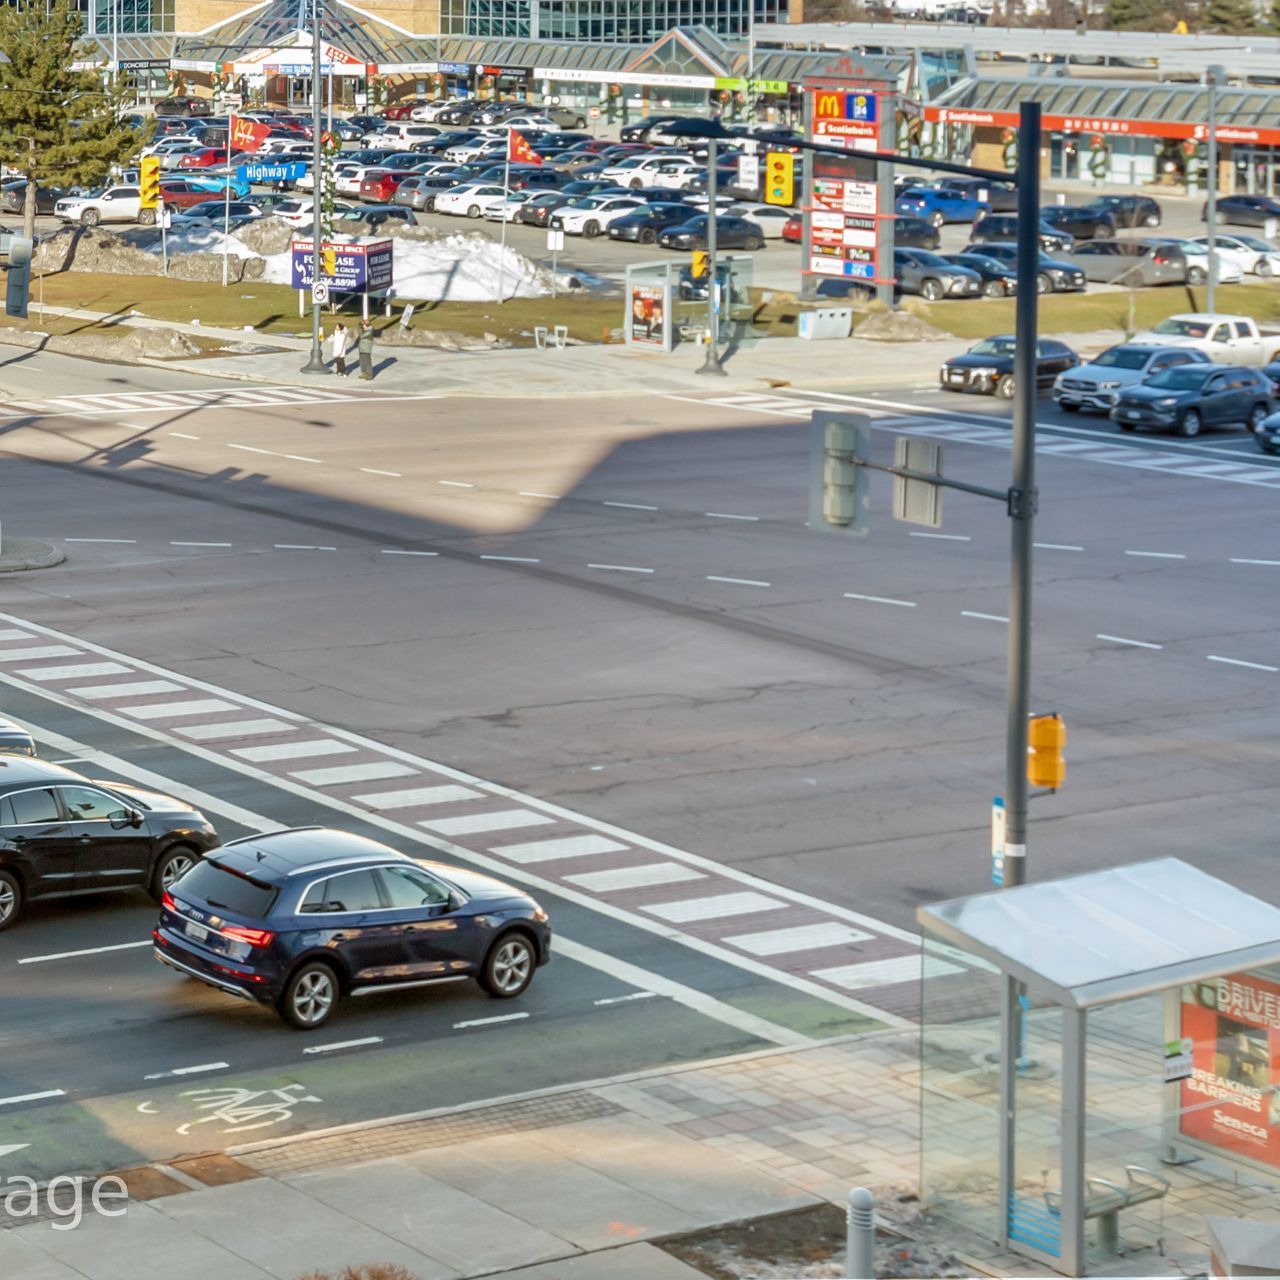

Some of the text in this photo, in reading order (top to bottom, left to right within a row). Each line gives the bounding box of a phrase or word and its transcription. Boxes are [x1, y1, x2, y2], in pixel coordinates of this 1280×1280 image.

[948, 112, 993, 122] Scotiabank
[827, 124, 874, 136] Scotiabank
[246, 165, 296, 180] Highway 7
[1187, 1077, 1262, 1113] BARRIERS
[1213, 1109, 1268, 1139] Seneca
